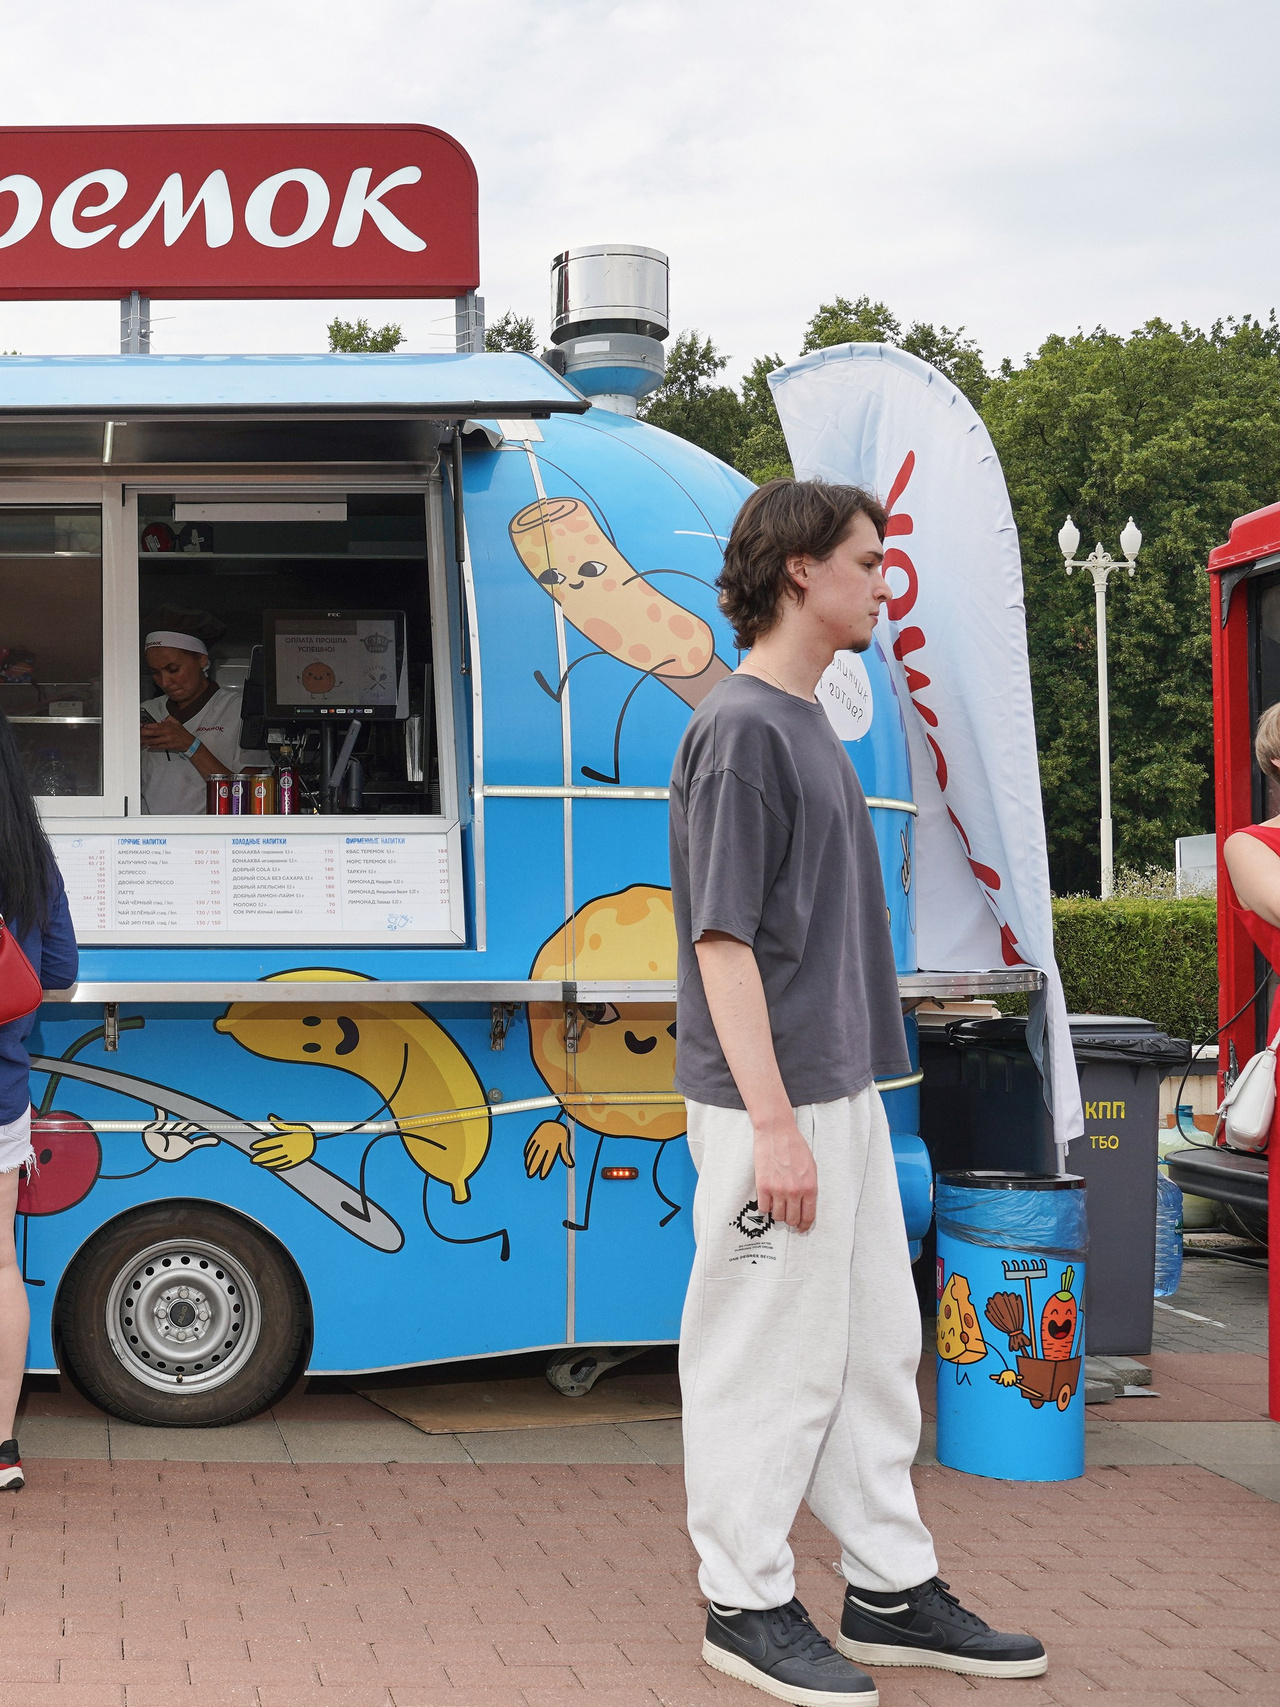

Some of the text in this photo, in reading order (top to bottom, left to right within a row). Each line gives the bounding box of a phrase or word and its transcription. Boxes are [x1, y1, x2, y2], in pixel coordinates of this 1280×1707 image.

[829, 682, 864, 723] готов?
[232, 838, 261, 846] ХОЛОДНЫЕ
[1085, 1101, 1125, 1119] КПП
[1089, 1135, 1119, 1150] ТБО
